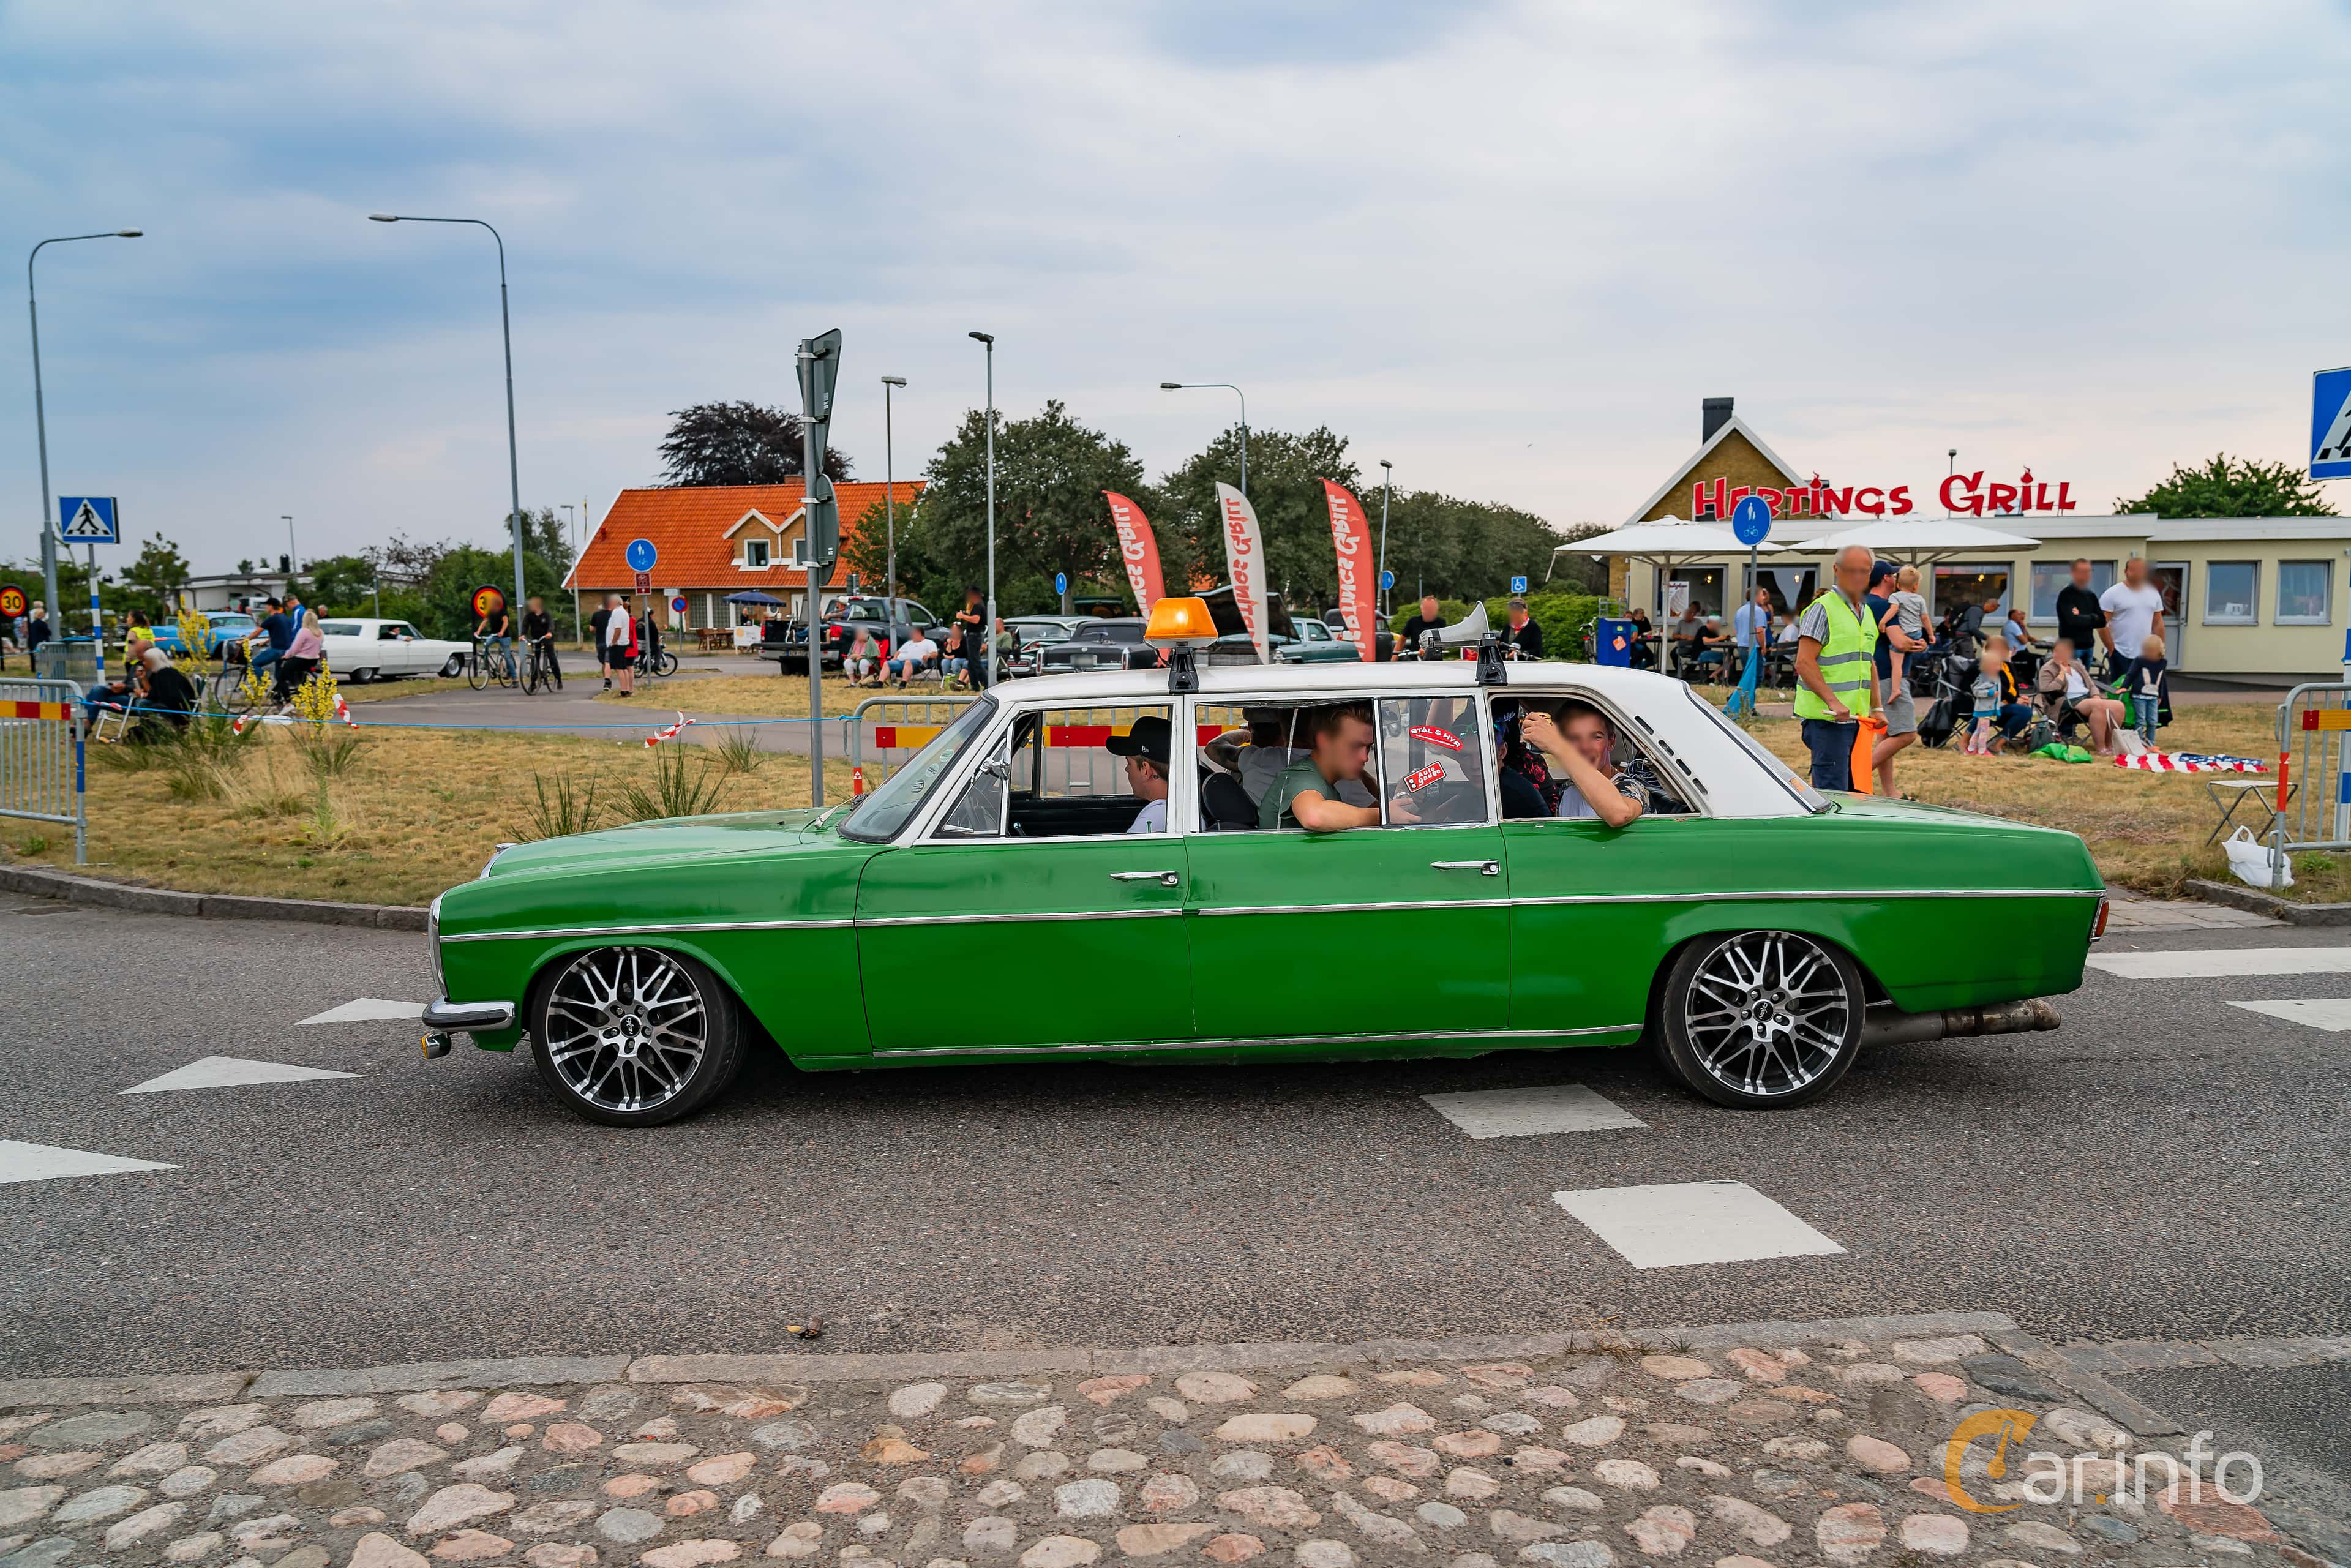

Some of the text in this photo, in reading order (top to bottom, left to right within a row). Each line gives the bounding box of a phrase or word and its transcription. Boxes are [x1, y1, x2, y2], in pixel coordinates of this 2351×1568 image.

[1939, 465, 2077, 517] GRILL
[3, 595, 22, 609] 30
[1443, 733, 1461, 748] HYR
[1418, 769, 1441, 786] gauge
[1419, 767, 1435, 778] Auto
